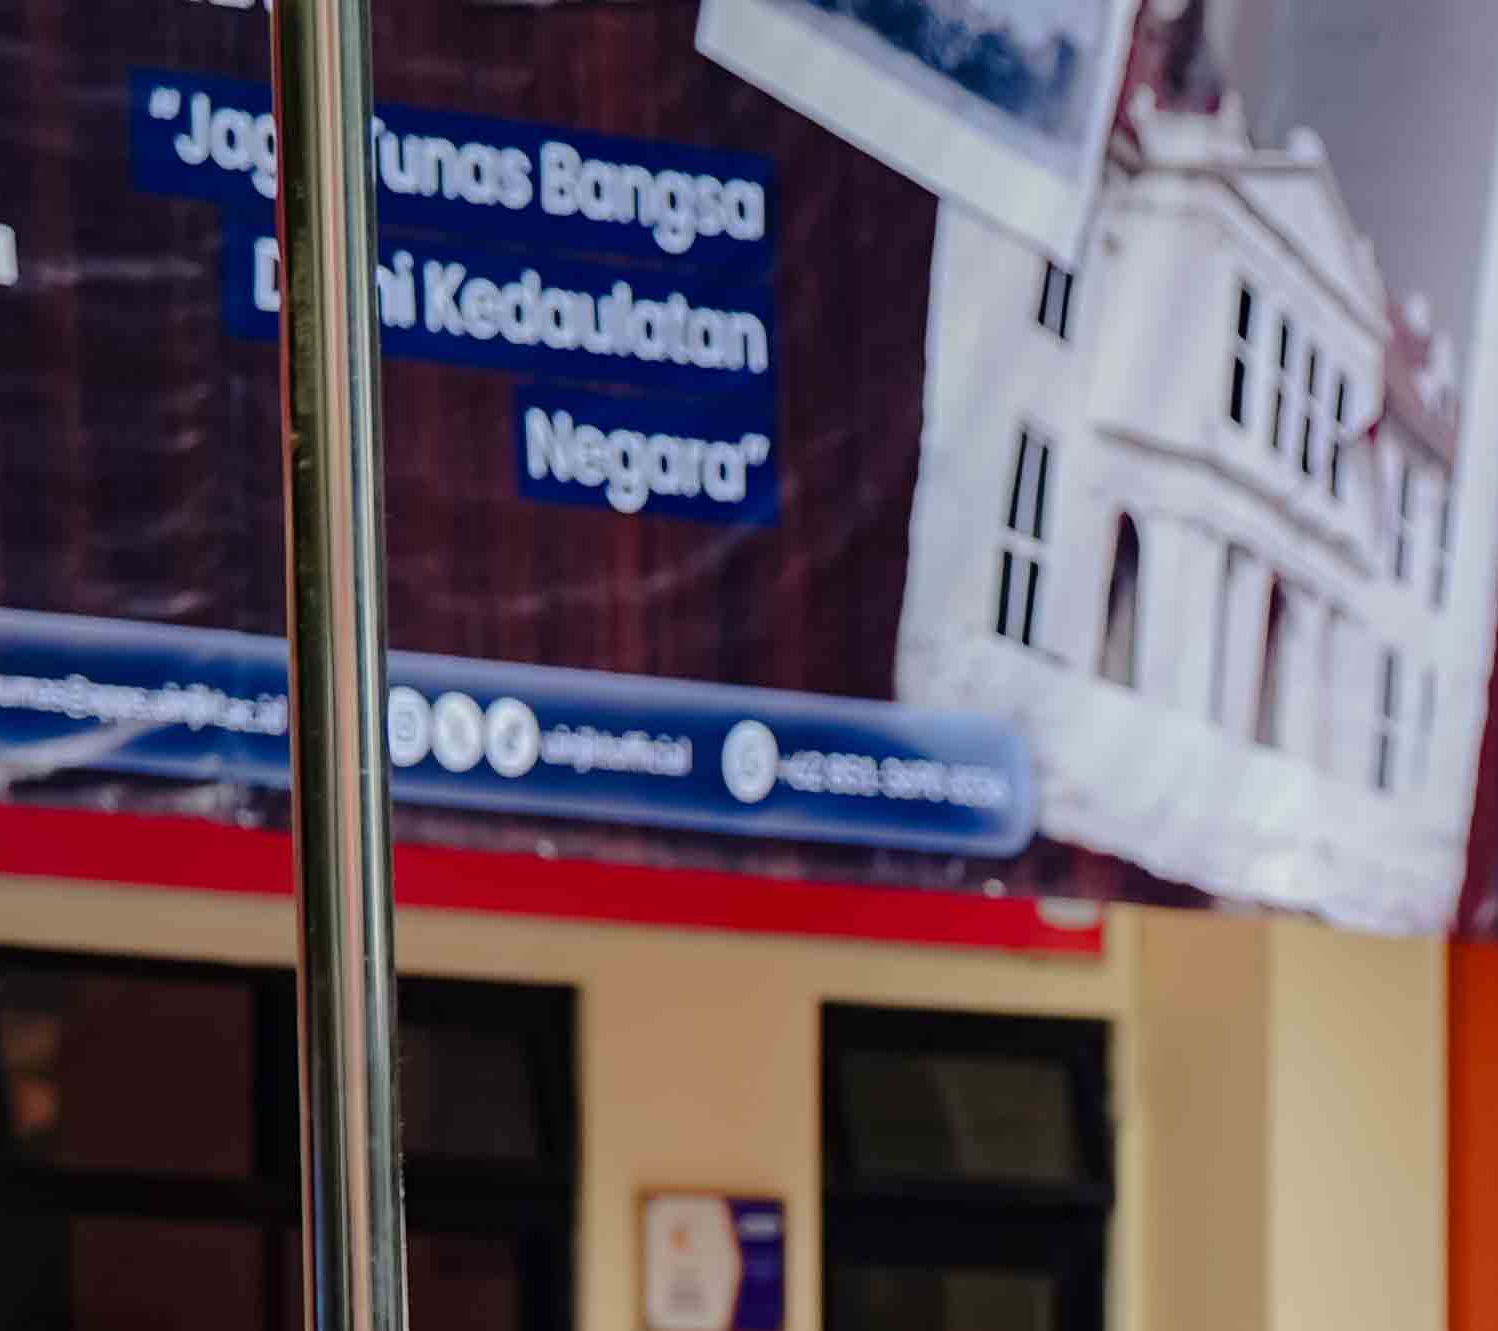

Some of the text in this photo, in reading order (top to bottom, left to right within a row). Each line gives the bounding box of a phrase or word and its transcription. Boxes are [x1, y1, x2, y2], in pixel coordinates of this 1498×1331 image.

[149, 85, 279, 199] "Jag
[540, 141, 766, 254] Bangsa
[254, 237, 769, 375] Di Kedaulatan
[524, 406, 771, 514] Negara"
